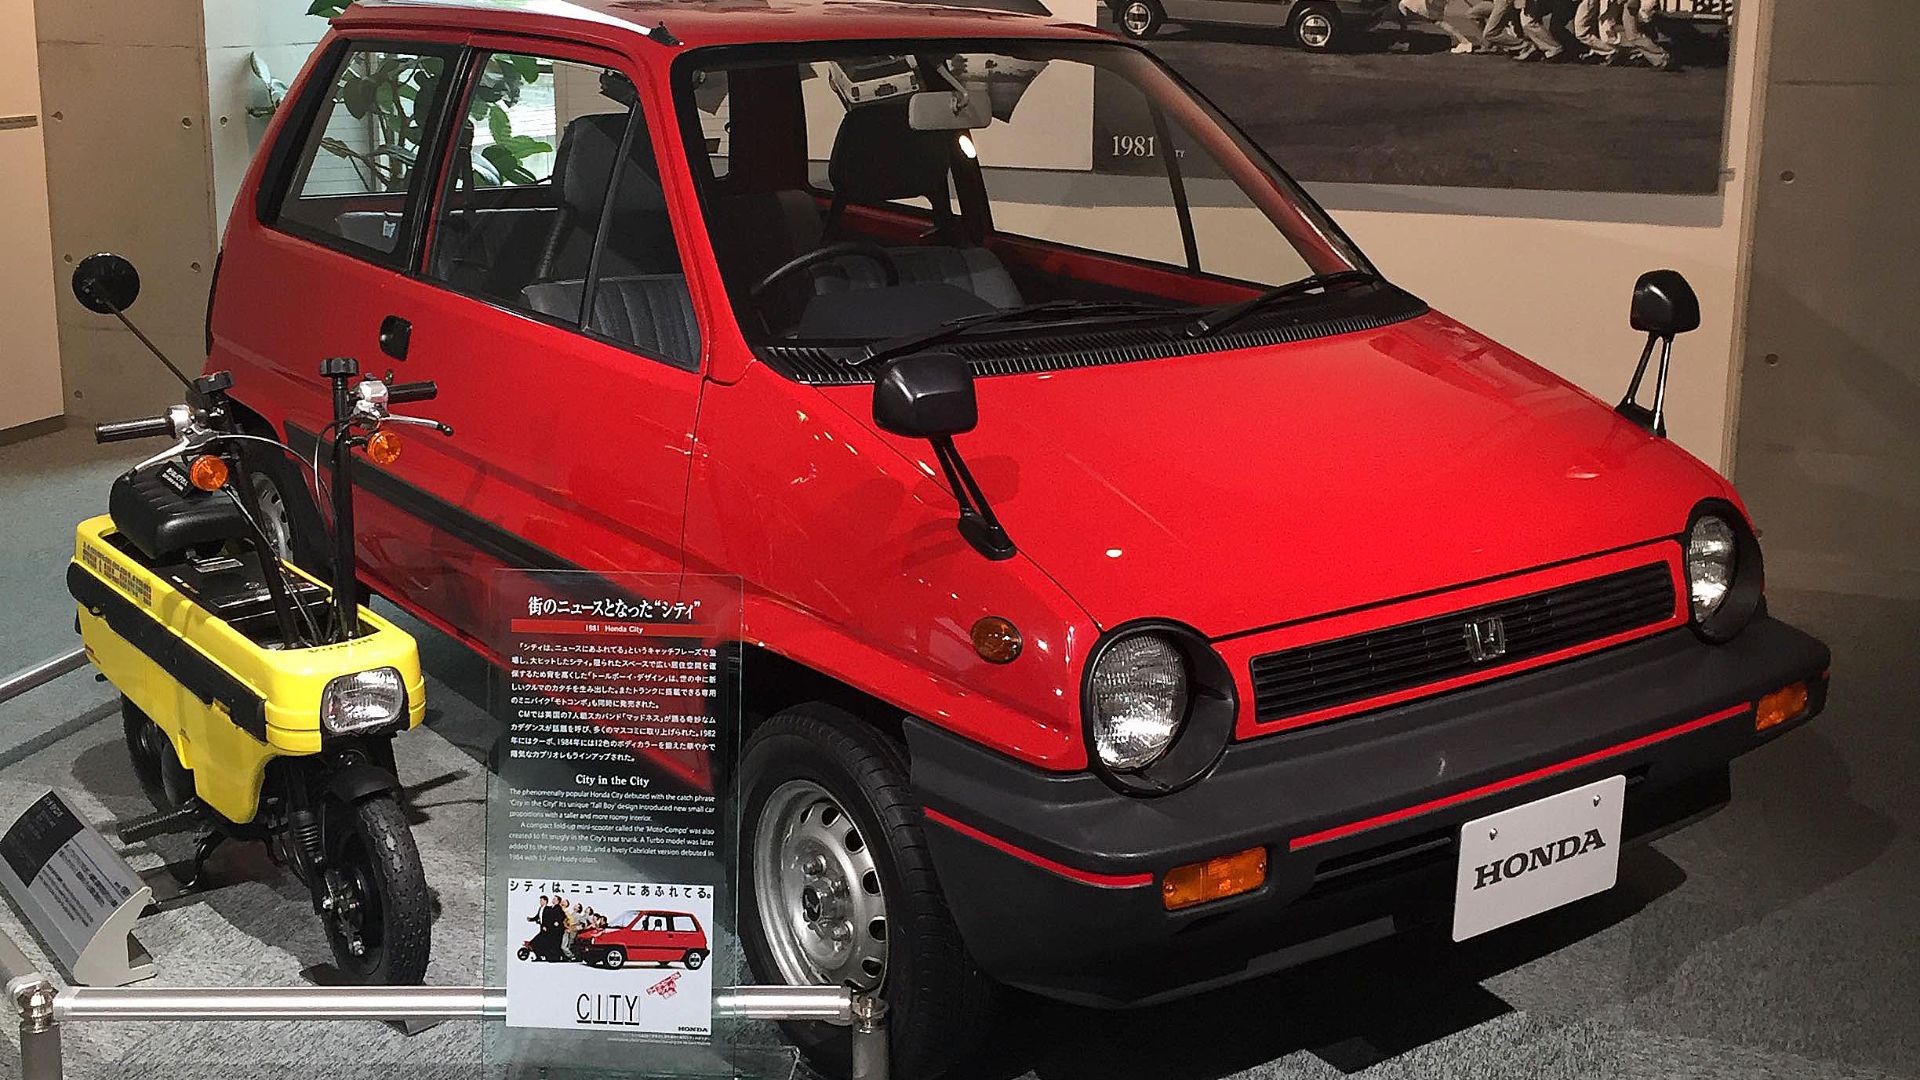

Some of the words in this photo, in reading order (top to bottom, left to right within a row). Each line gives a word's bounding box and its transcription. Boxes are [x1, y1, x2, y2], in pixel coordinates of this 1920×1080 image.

[1112, 135, 1155, 157] 1981
[528, 596, 701, 620] 街のニュースとなった“シティ”
[585, 624, 600, 632] 1981
[604, 624, 627, 632] Honda
[628, 626, 644, 634] City
[576, 774, 596, 786] City
[598, 775, 608, 784] in
[611, 776, 627, 785] the
[630, 776, 650, 788] City
[566, 790, 589, 798] popular
[611, 792, 623, 800] City
[624, 792, 650, 800] debuted
[617, 803, 638, 811] design
[612, 847, 628, 855] lively
[1474, 828, 1606, 890] HONDA
[510, 880, 711, 899] シティは、ニュースにあふれてる。
[576, 994, 638, 1021] CITY
